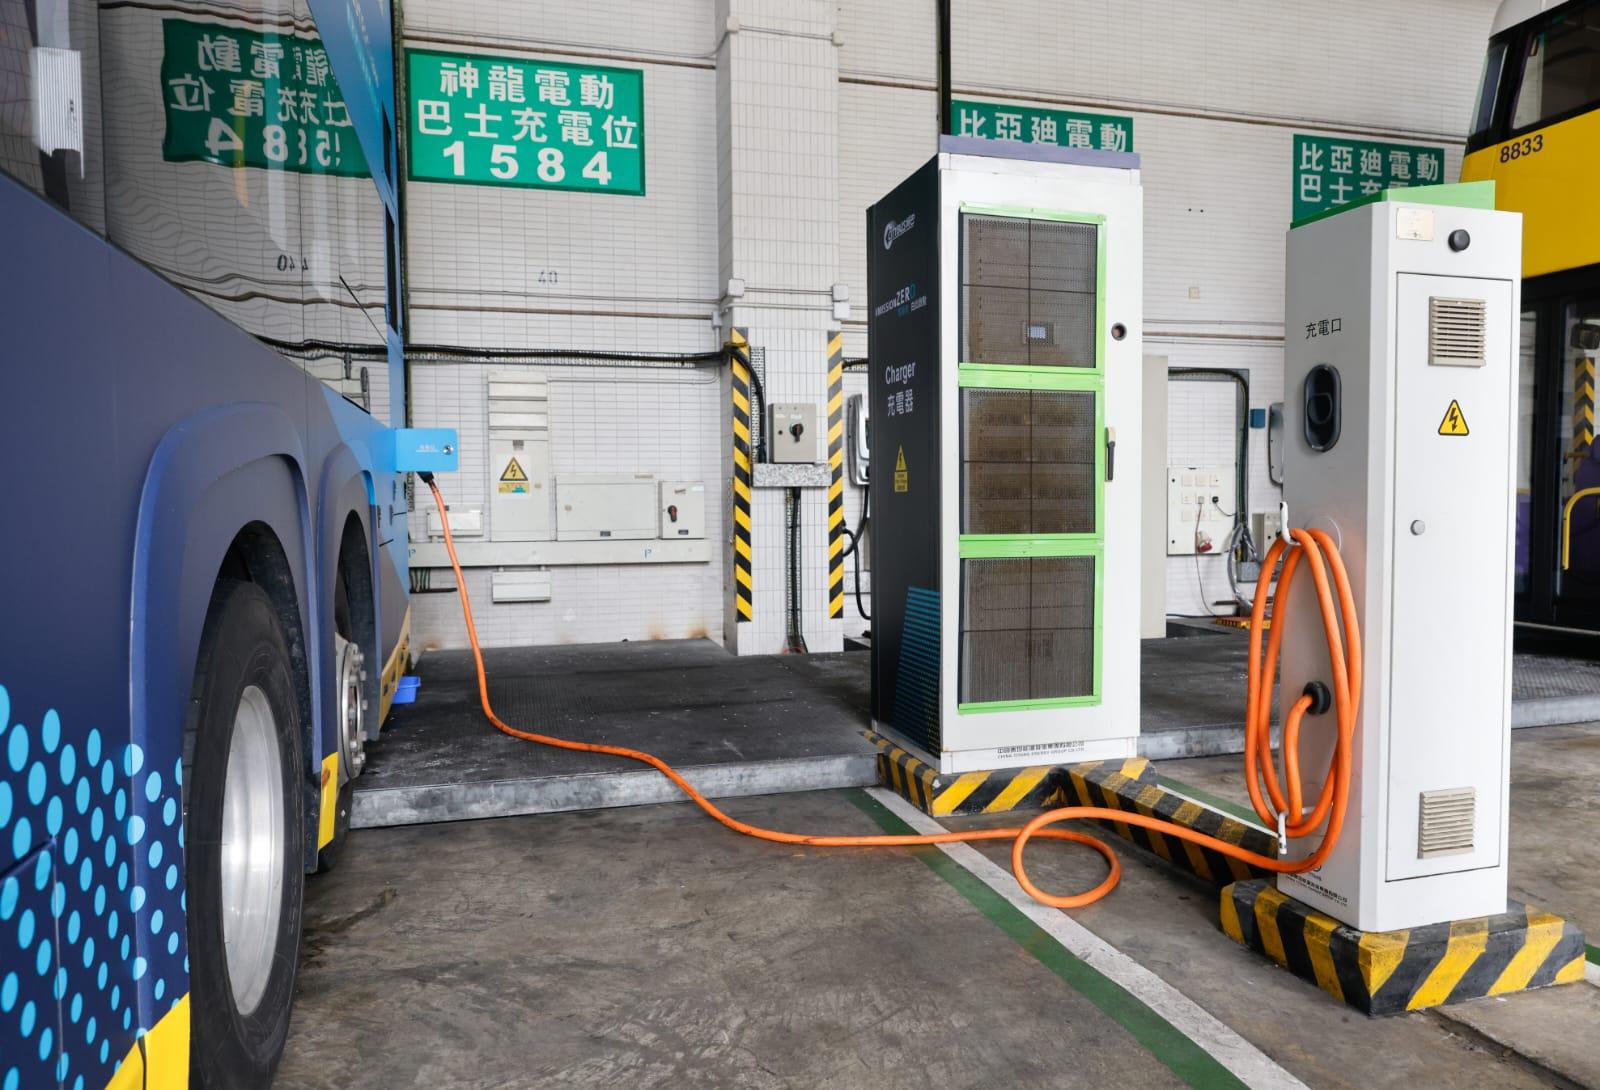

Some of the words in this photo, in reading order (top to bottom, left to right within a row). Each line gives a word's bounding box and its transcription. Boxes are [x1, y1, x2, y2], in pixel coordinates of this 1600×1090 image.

[440, 62, 614, 110] 神龍電動
[418, 99, 638, 149] 巴士充電位
[443, 141, 612, 185] 1584
[1500, 134, 1543, 164] 8833
[1300, 174, 1409, 204] 巴士充
[1305, 318, 1342, 339] 充電口
[885, 362, 916, 384] Charger
[887, 389, 914, 416] 充電器
